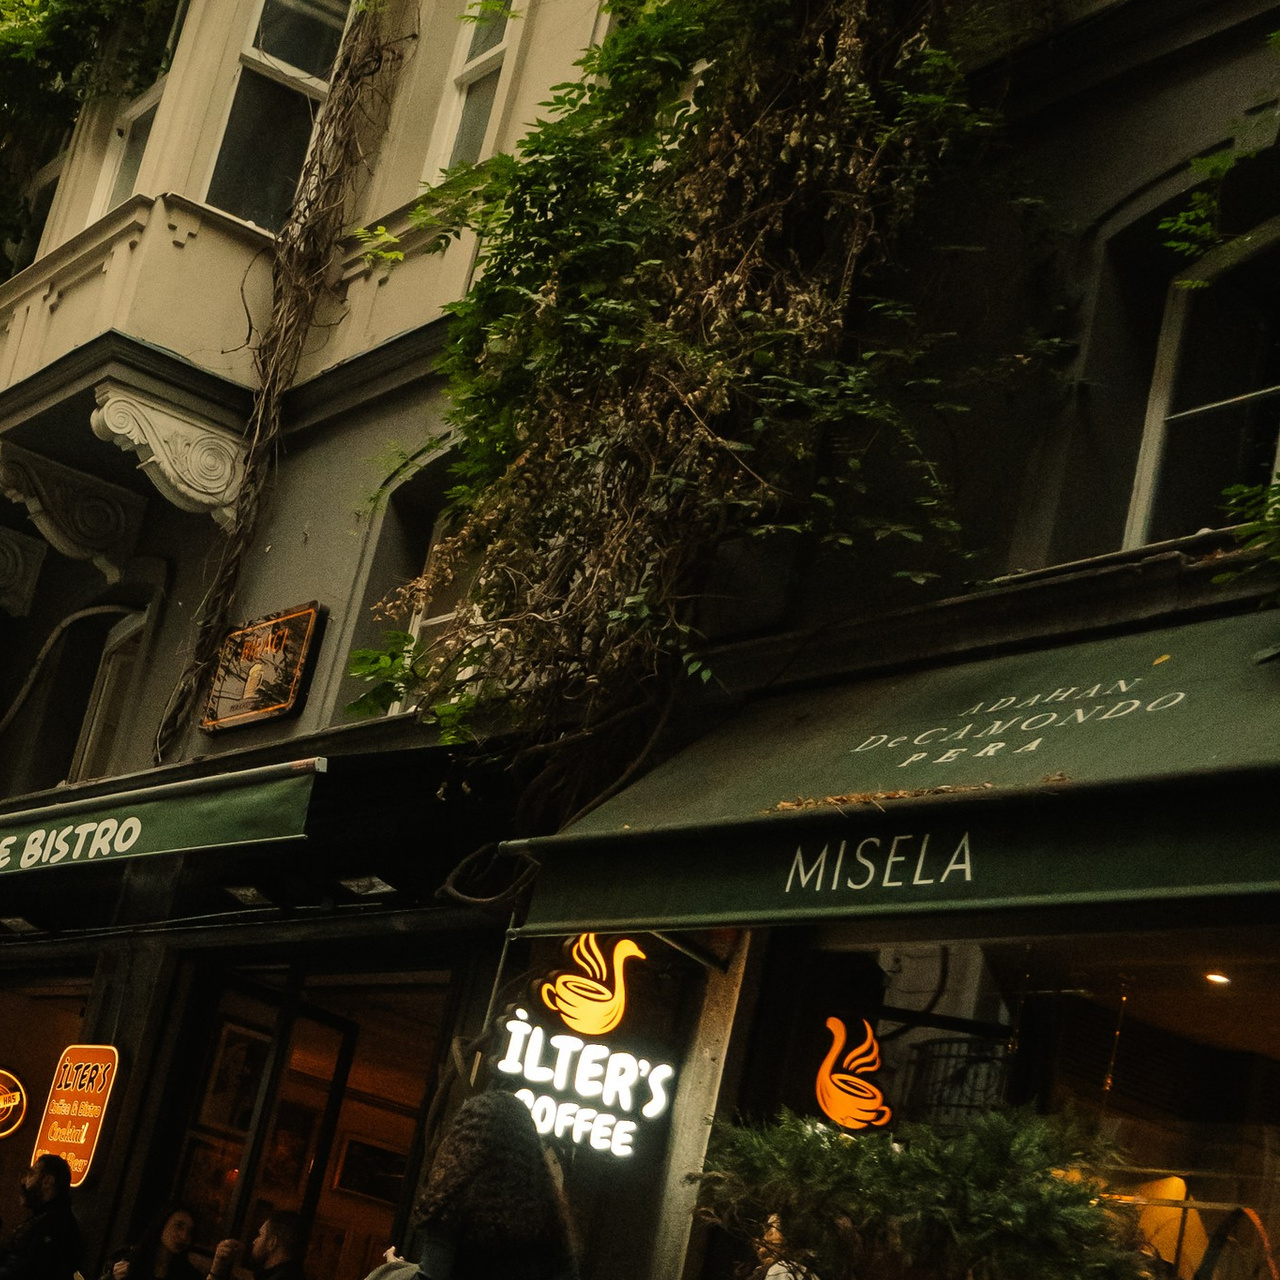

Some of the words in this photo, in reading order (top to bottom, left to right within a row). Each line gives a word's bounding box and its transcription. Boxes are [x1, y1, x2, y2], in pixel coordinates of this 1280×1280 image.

[957, 677, 1143, 718] ADAHAN
[897, 736, 1046, 769] PERA
[19, 816, 143, 869] BISTRO
[784, 831, 973, 893] MISELA
[3, 1094, 17, 1106] HAS
